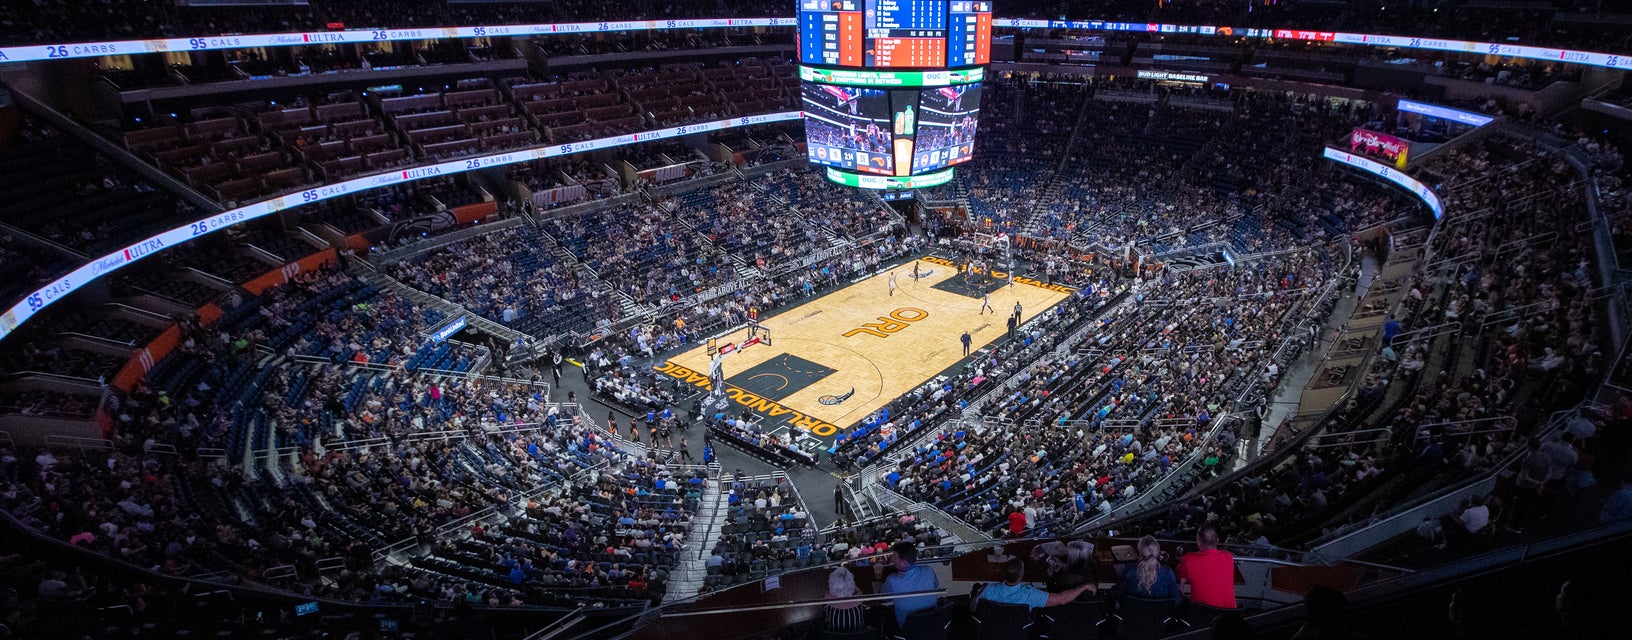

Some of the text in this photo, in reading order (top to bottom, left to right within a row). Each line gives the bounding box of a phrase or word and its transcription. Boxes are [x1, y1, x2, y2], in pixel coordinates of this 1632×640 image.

[610, 22, 632, 31] CARBS
[666, 20, 694, 29] 95 CALS
[731, 19, 752, 27] ULTRA
[1010, 18, 1020, 27] 95
[473, 26, 509, 36] 95 CALS
[556, 24, 581, 33] ULTRA
[308, 33, 344, 43] ULTRA
[391, 30, 422, 38] CARBS
[189, 38, 240, 50] 95 CALS
[1367, 35, 1391, 44] ULTRA
[1423, 39, 1448, 48] CARBS
[73, 44, 116, 55] CARBS
[1489, 44, 1521, 55] 95 CALS
[1564, 51, 1590, 62] ULTRA
[1168, 73, 1196, 81] BASELINE
[741, 115, 767, 125] 95 CALS
[688, 124, 709, 133] CARBS
[638, 131, 661, 141] ULTRA
[560, 142, 595, 154] 95 CALS
[483, 155, 513, 165] CARBS
[407, 166, 442, 179] ULTRA
[302, 184, 348, 202] 95 CALS
[210, 210, 245, 228] CARBS
[129, 237, 165, 260] ULTRA
[1014, 275, 1077, 295] MAGIC
[27, 279, 72, 312] 95 CALS
[842, 307, 929, 339] ORL
[440, 319, 465, 339] BankUnited
[725, 387, 838, 437] ORLANDO
